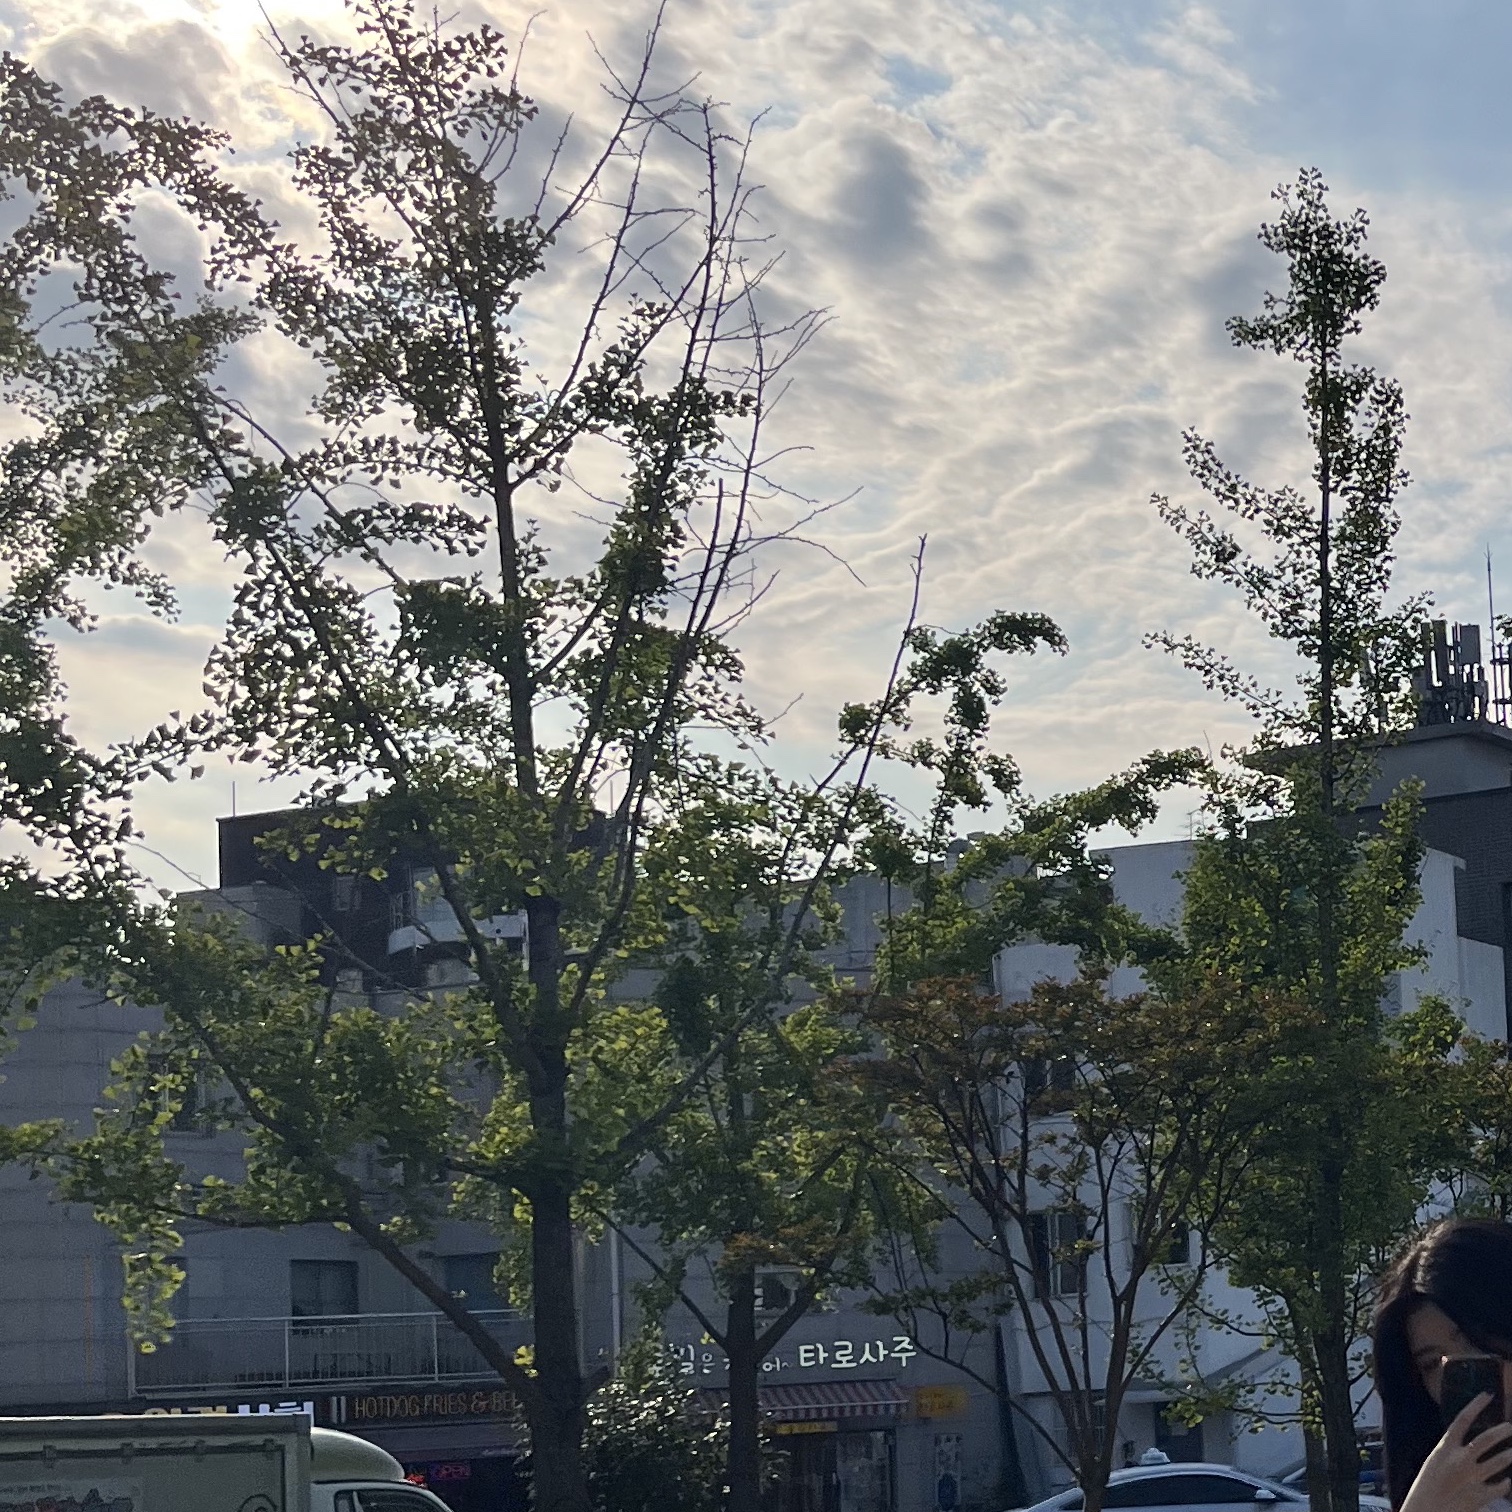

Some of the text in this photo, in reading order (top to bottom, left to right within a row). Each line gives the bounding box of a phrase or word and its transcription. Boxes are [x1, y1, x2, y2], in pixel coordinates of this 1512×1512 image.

[799, 1335, 917, 1370] 타로사주
[424, 1392, 467, 1415] FRIES
[471, 1391, 489, 1414] &
